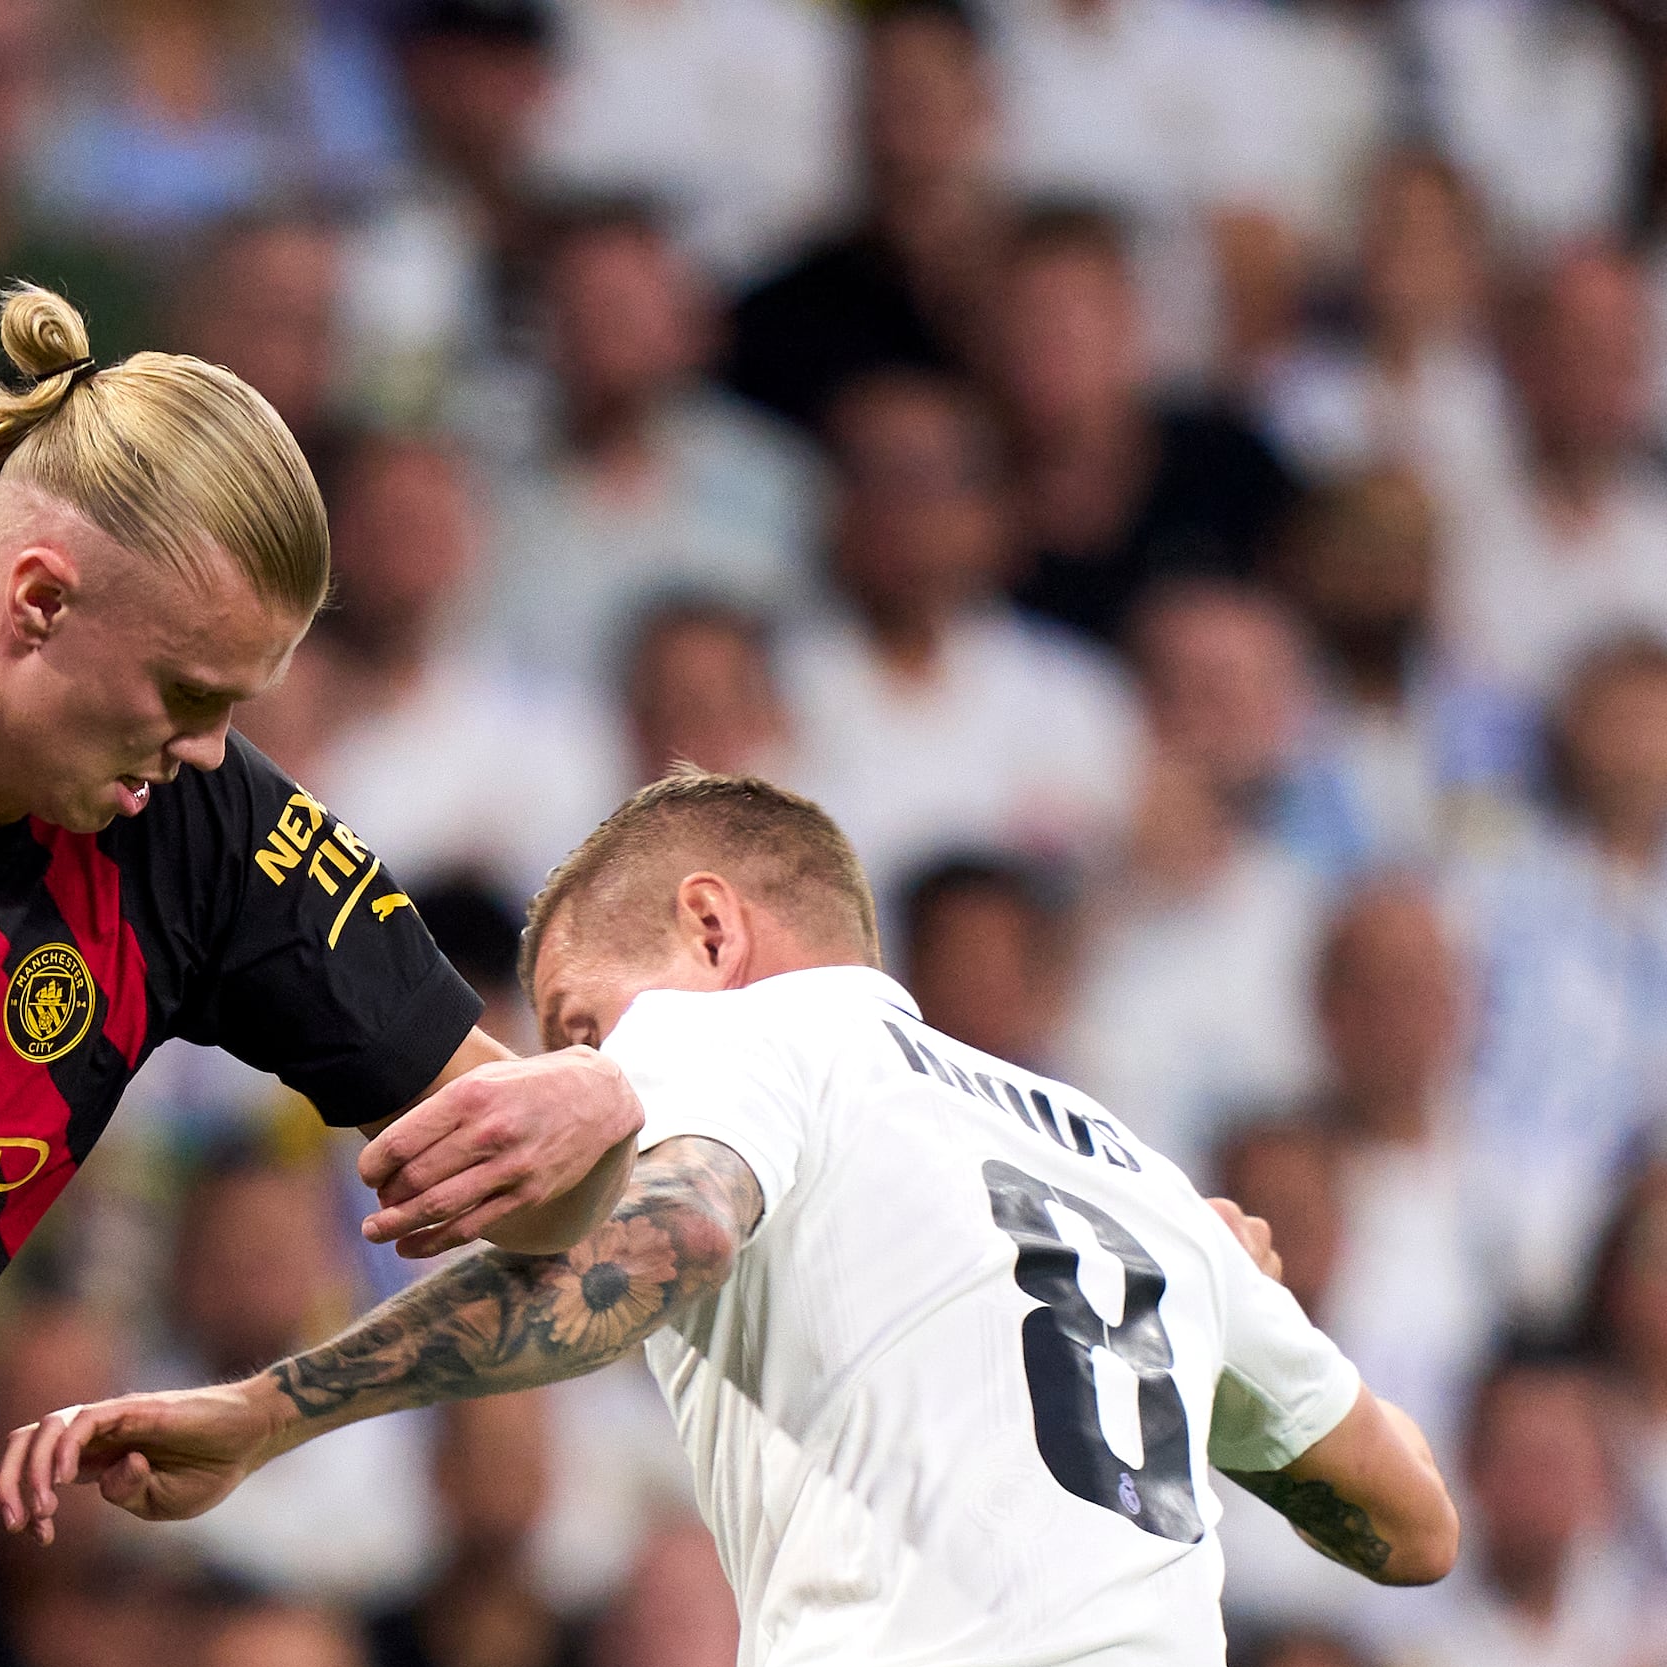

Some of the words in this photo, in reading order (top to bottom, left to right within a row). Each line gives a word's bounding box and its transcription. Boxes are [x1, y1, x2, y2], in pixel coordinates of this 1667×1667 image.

[16, 952, 84, 990] MANCHESTER
[28, 1042, 54, 1053] CITY
[981, 1158, 1205, 1544] 8
